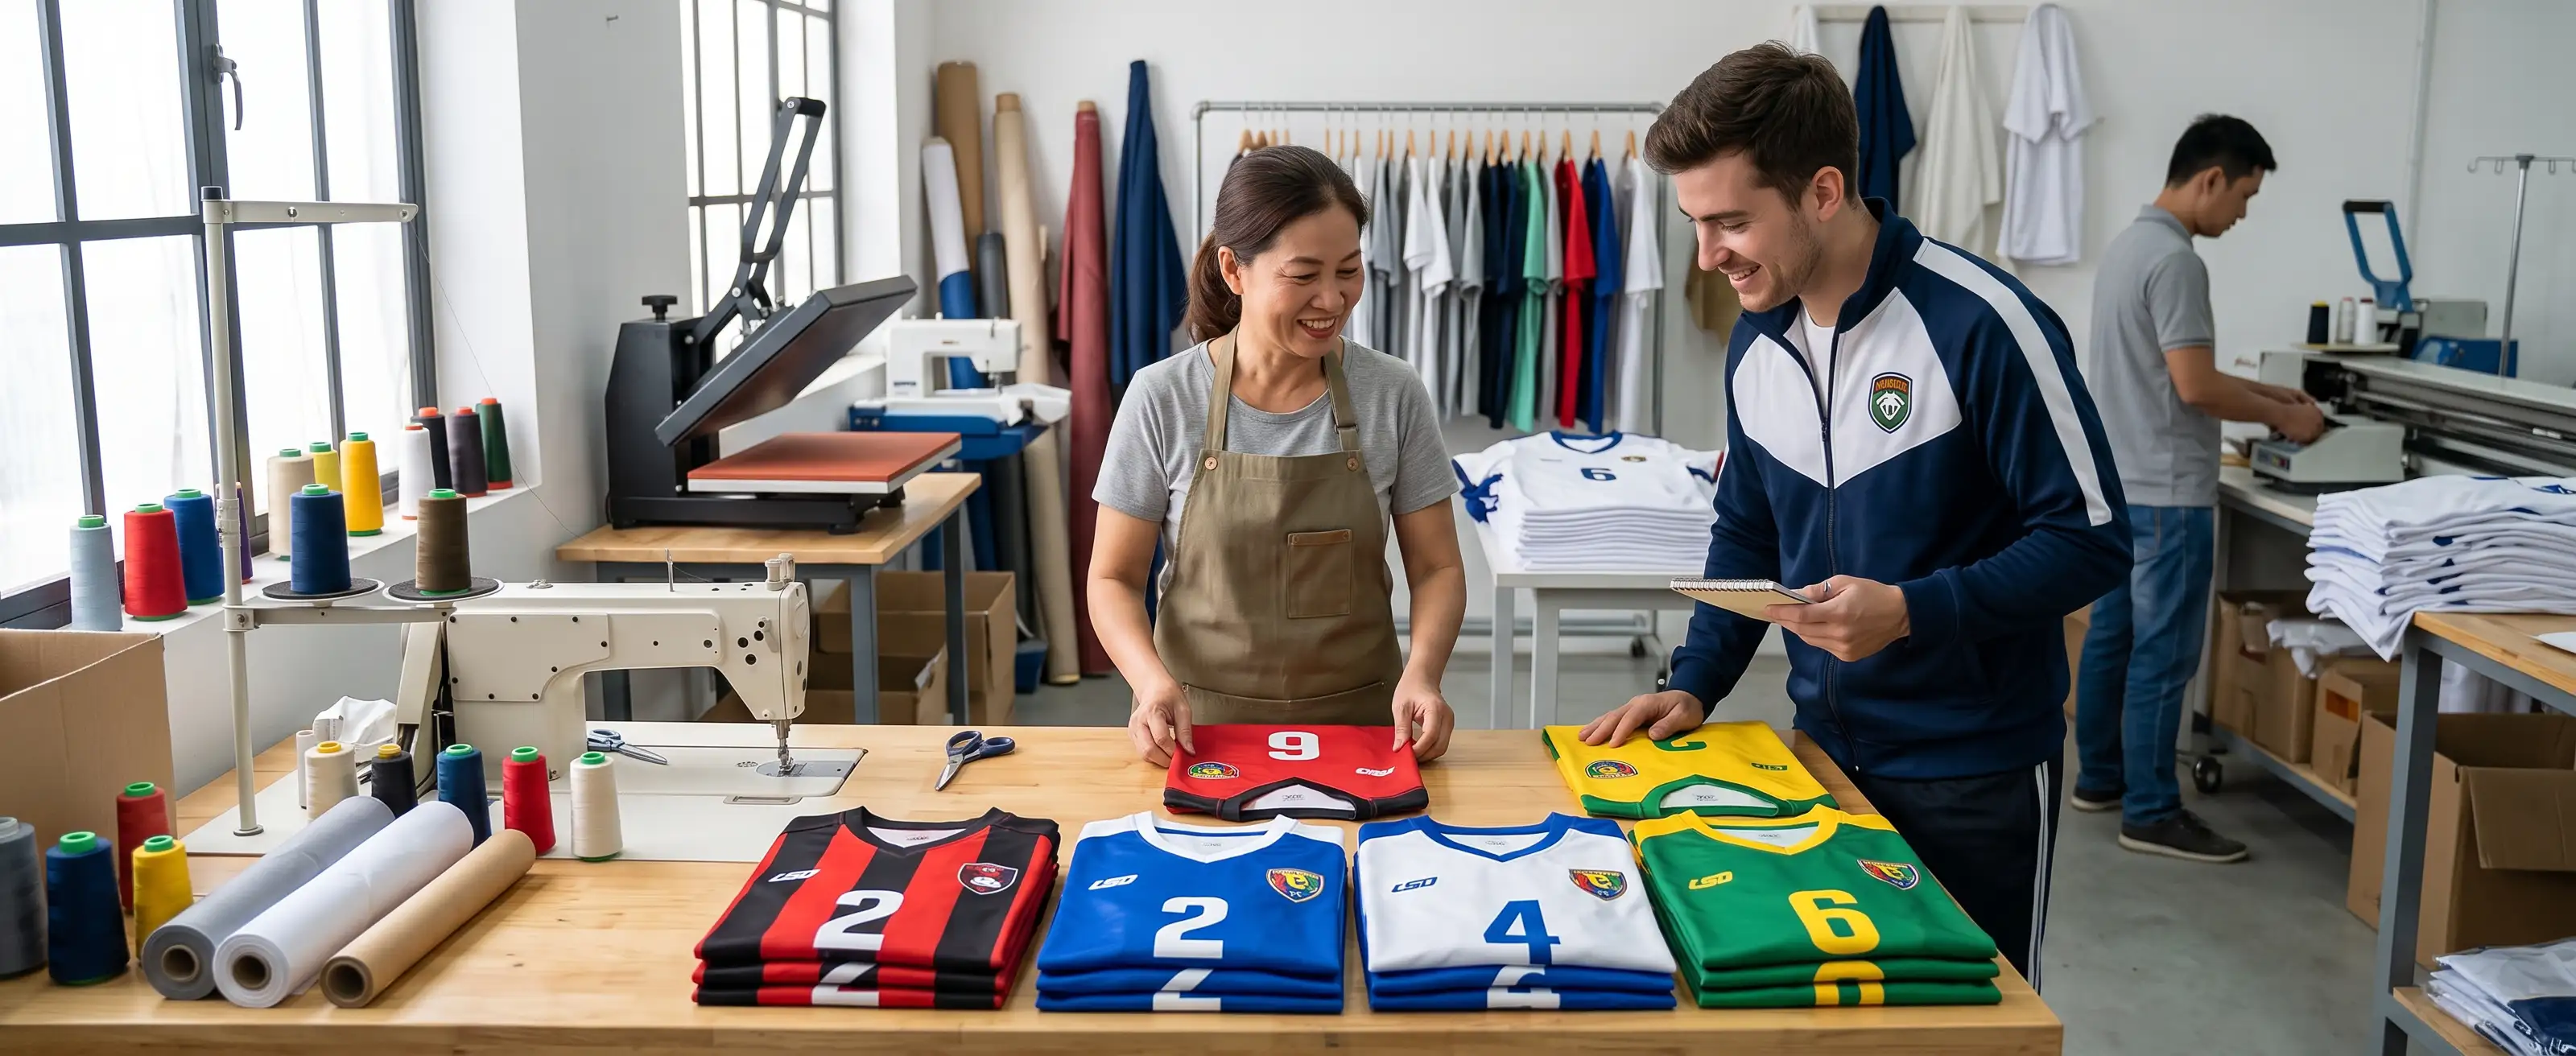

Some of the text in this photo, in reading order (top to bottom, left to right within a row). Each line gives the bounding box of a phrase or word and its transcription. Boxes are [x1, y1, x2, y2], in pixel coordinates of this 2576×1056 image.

[1580, 468, 1616, 481] 6
[768, 868, 821, 883] LSD
[1088, 874, 1139, 891] LSD
[1391, 877, 1438, 893] LSD
[1688, 871, 1733, 890] LSD
[813, 889, 905, 951] 2
[1153, 896, 1229, 959] 2
[1788, 889, 1880, 955] 6
[1483, 899, 1562, 966] 4
